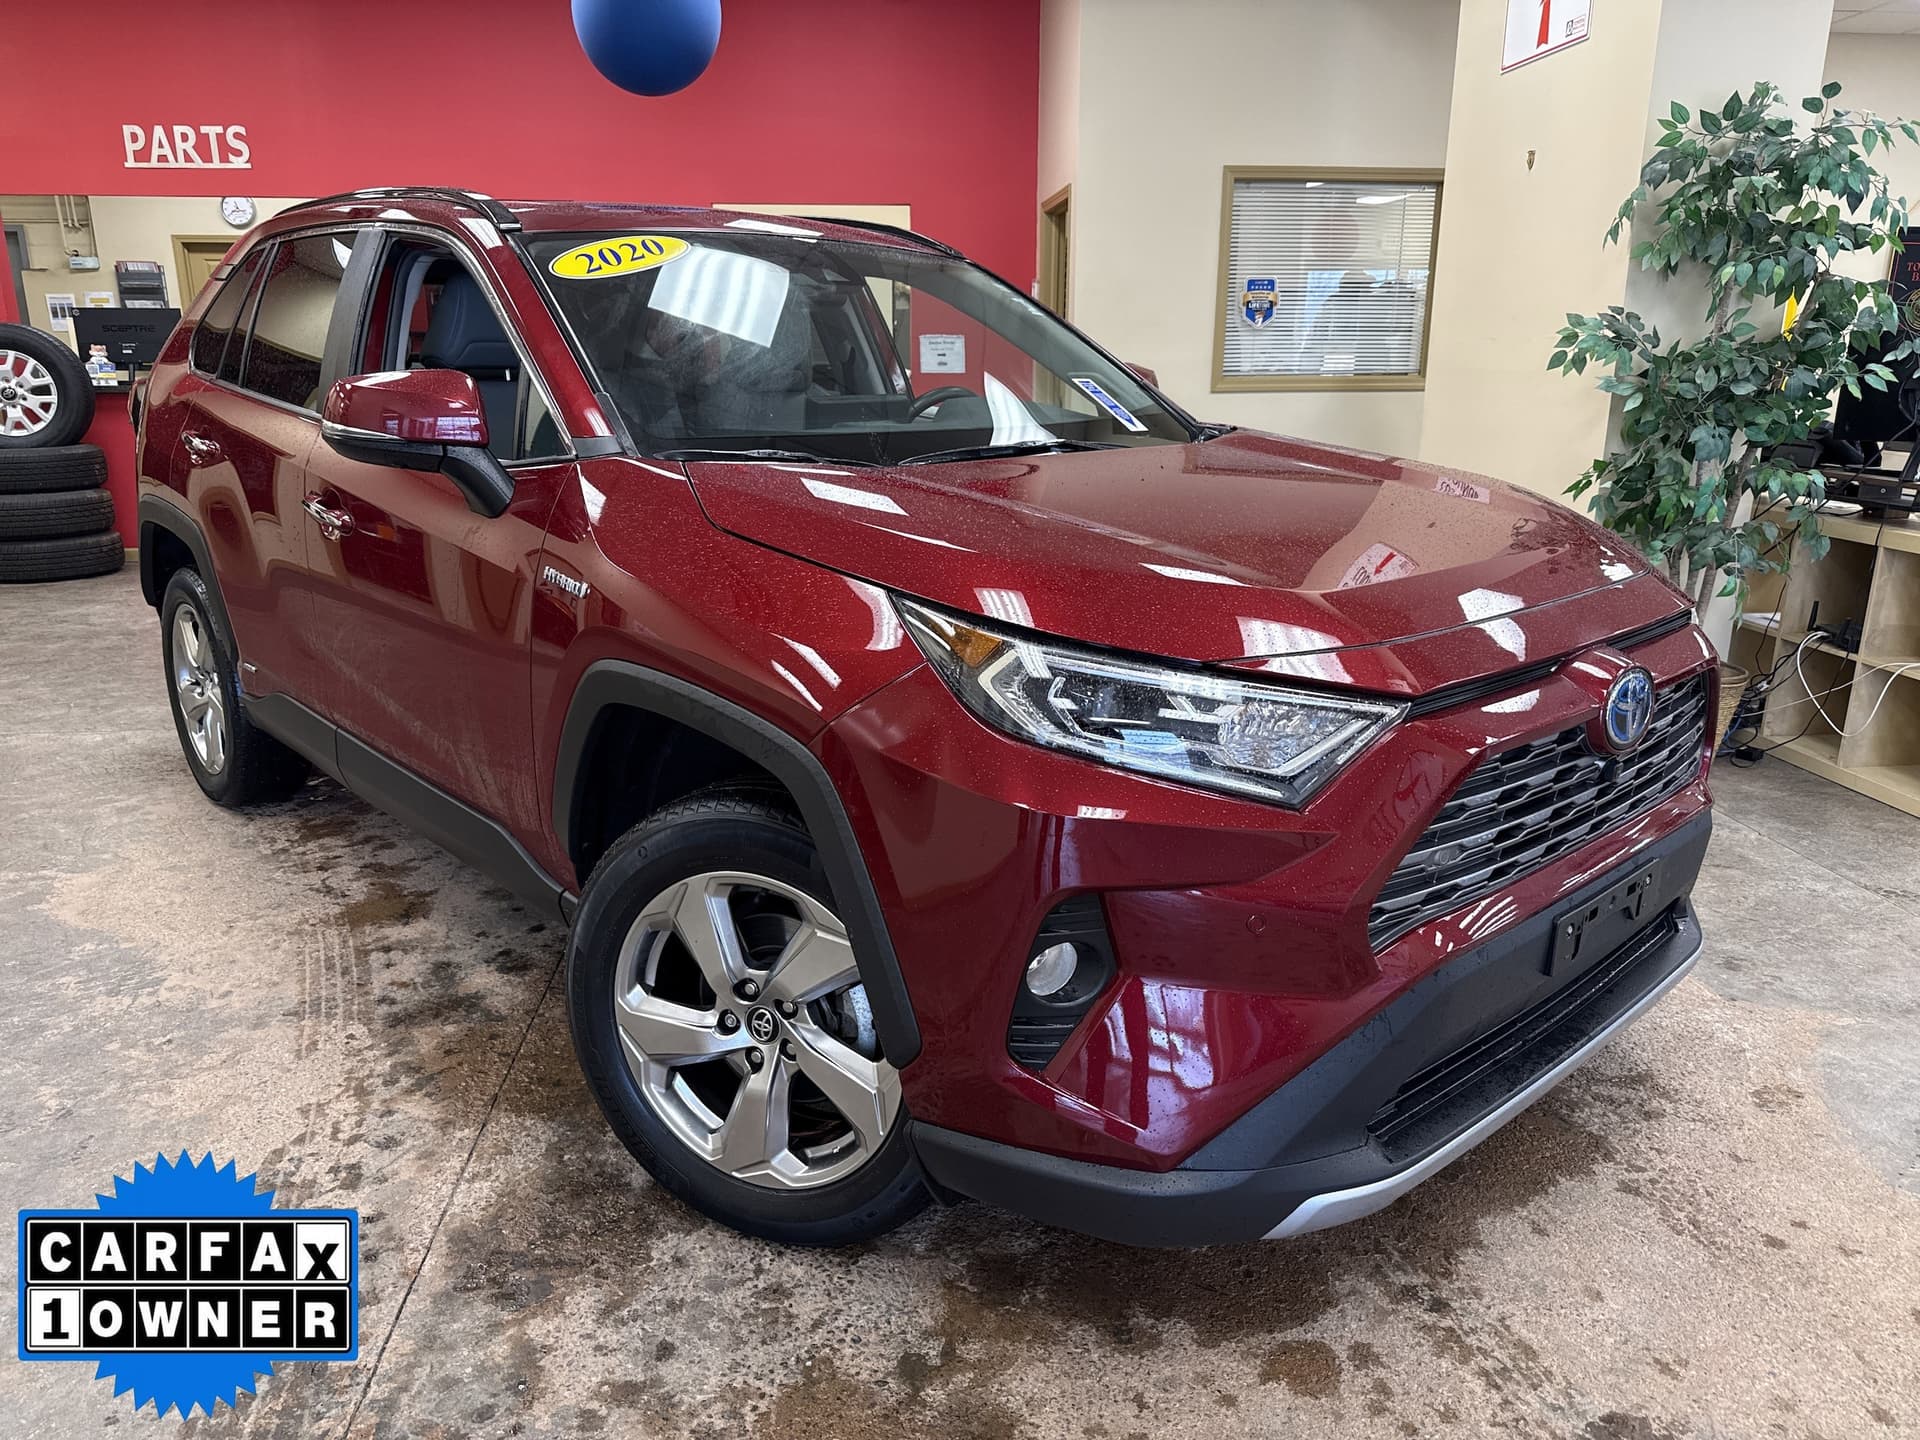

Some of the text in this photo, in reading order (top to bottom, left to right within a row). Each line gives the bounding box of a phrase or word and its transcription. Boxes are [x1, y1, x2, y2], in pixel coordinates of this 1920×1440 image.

[122, 124, 251, 165] PARTS
[575, 239, 665, 274] 2020
[101, 324, 157, 333] SCEPTRE
[543, 565, 590, 598] HYBRID
